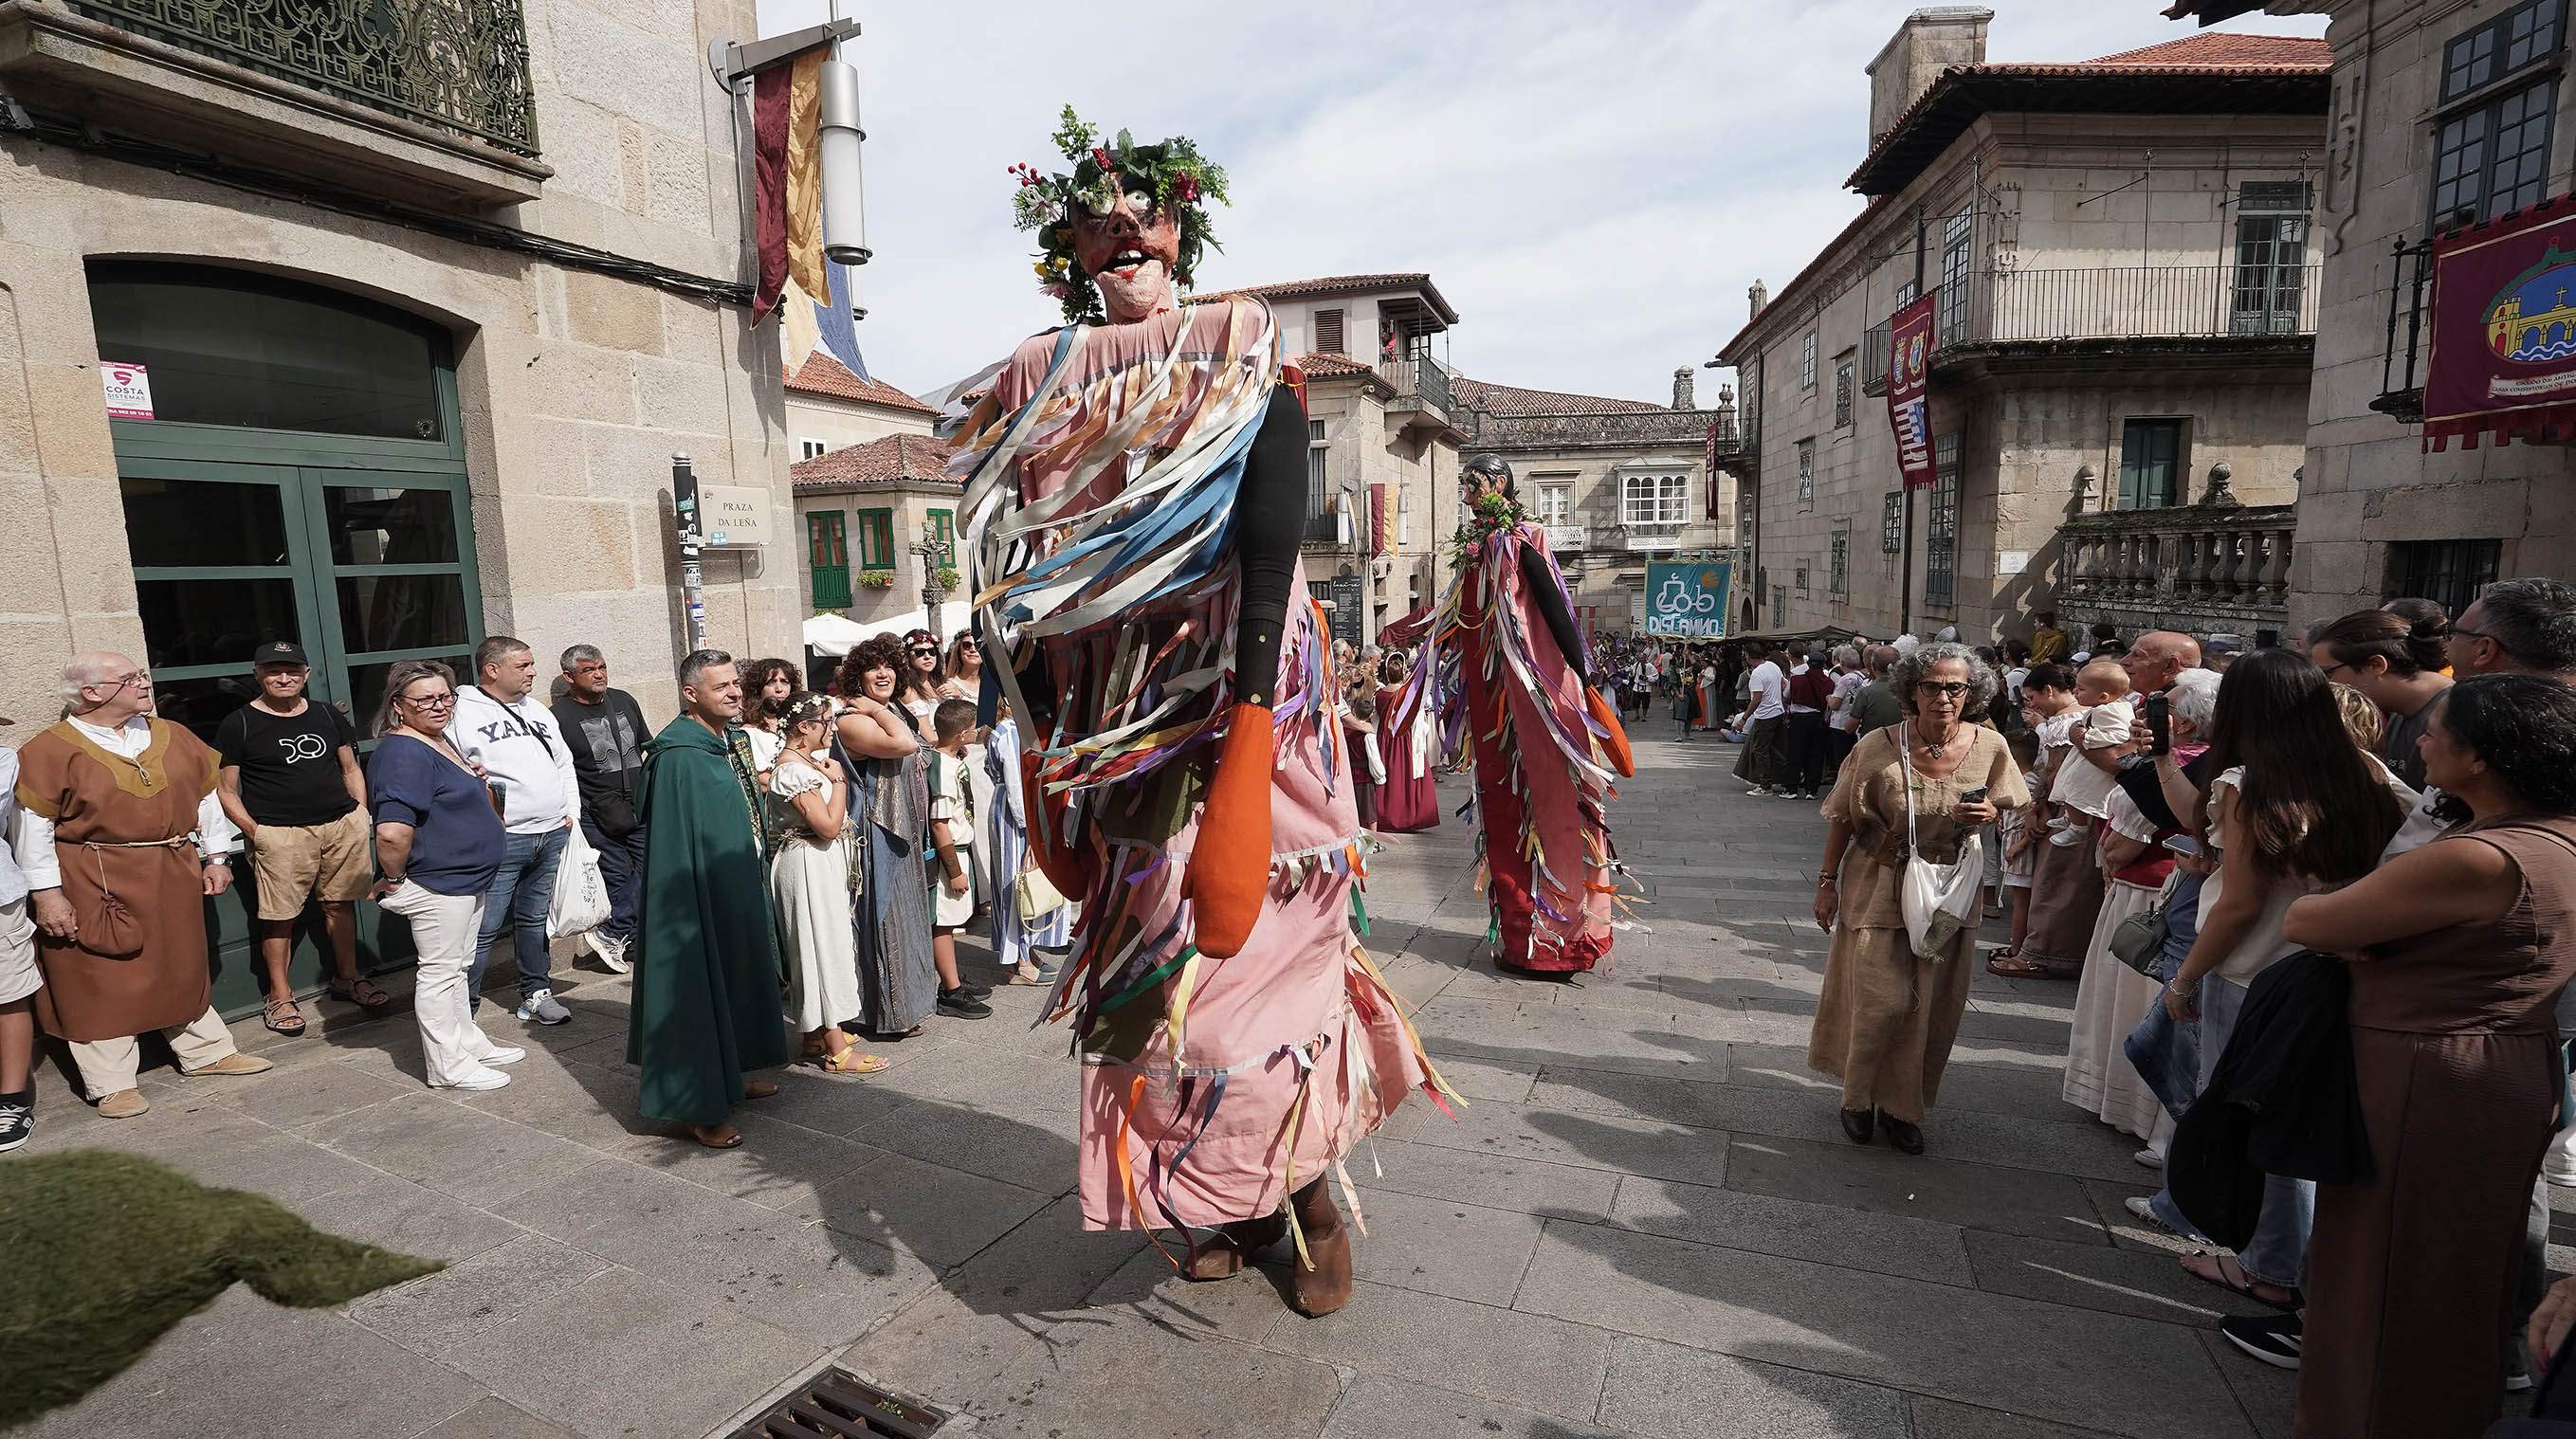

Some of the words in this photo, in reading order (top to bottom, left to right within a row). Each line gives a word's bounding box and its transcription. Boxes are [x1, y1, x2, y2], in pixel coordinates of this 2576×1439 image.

[106, 386, 144, 395] COSTA
[722, 502, 754, 512] PRAZA
[718, 518, 730, 527] DA
[734, 517, 758, 527] LEÑA
